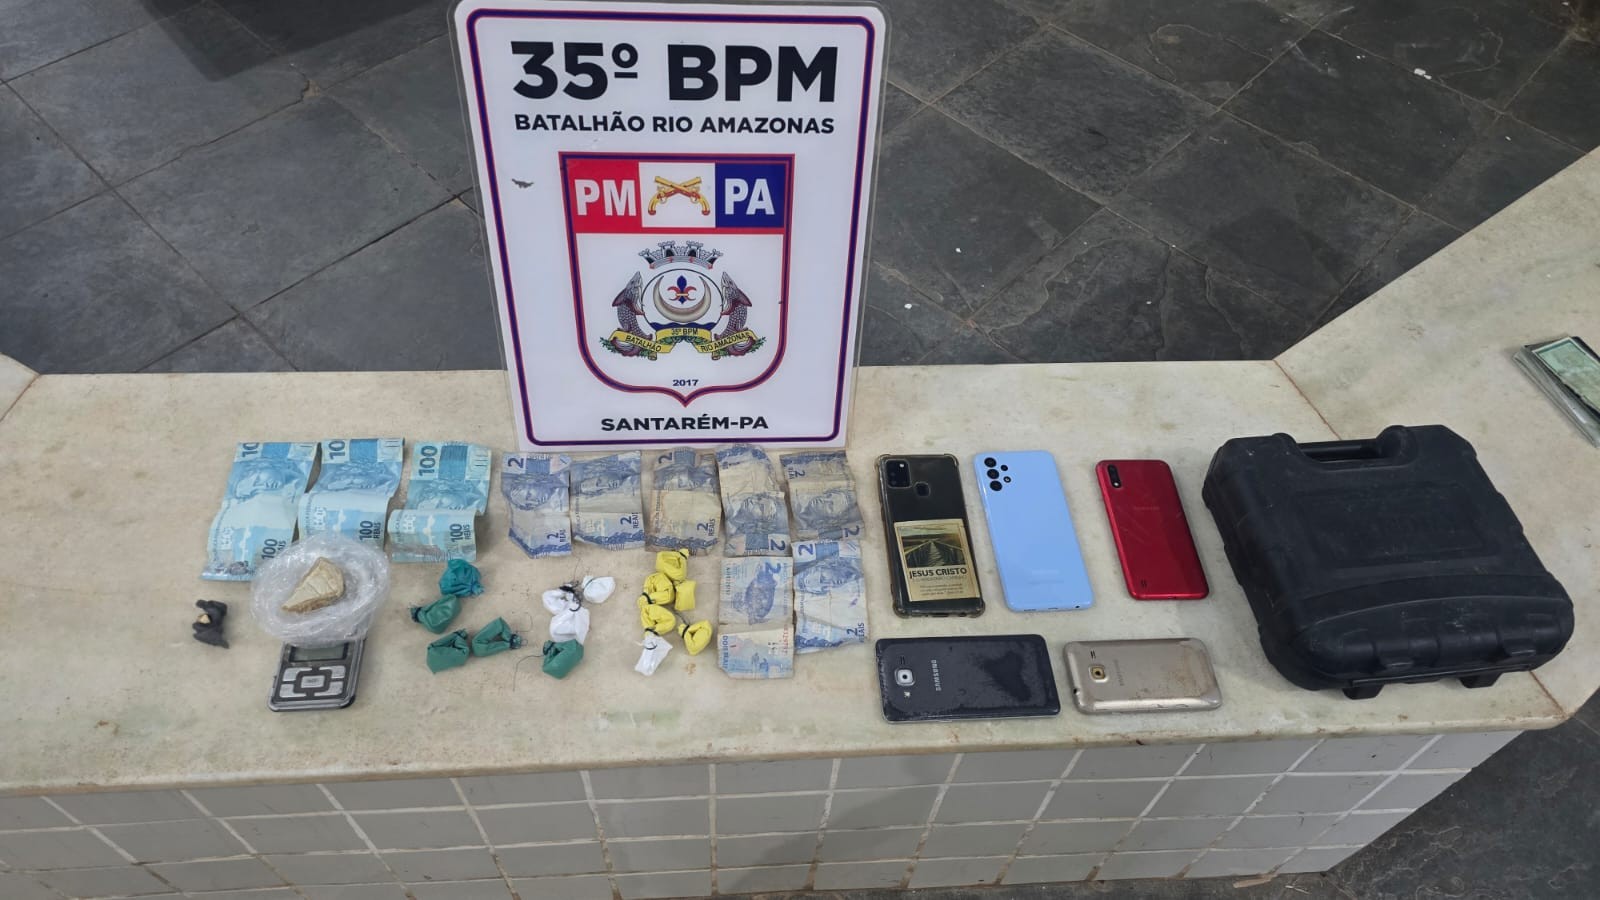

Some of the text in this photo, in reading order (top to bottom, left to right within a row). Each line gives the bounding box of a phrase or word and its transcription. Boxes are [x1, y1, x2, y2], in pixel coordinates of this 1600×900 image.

[510, 41, 839, 103] 35º BPM
[514, 111, 835, 135] BATALHÃO RIO AMAZONAS
[573, 179, 638, 217] PM
[724, 178, 776, 216] PA
[682, 327, 699, 336] BPM
[700, 331, 751, 352] RIO AMAZONAS
[672, 379, 699, 387] 2017
[601, 414, 769, 430] SANTARÉM-PA
[418, 445, 438, 477] 100
[507, 457, 525, 469] 2
[658, 452, 673, 465] 2
[620, 515, 632, 526] 2
[696, 522, 709, 532] 2
[359, 520, 374, 541] 100
[449, 523, 463, 543] 100
[546, 532, 560, 540] 2
[844, 525, 860, 538] 2
[261, 538, 278, 560] 100
[770, 538, 786, 551] 2
[797, 543, 814, 556] 2
[764, 562, 782, 574] 2
[909, 567, 967, 579] JESUS CRISTO
[846, 627, 858, 637] 2
[931, 659, 942, 691] SAMSUNG
